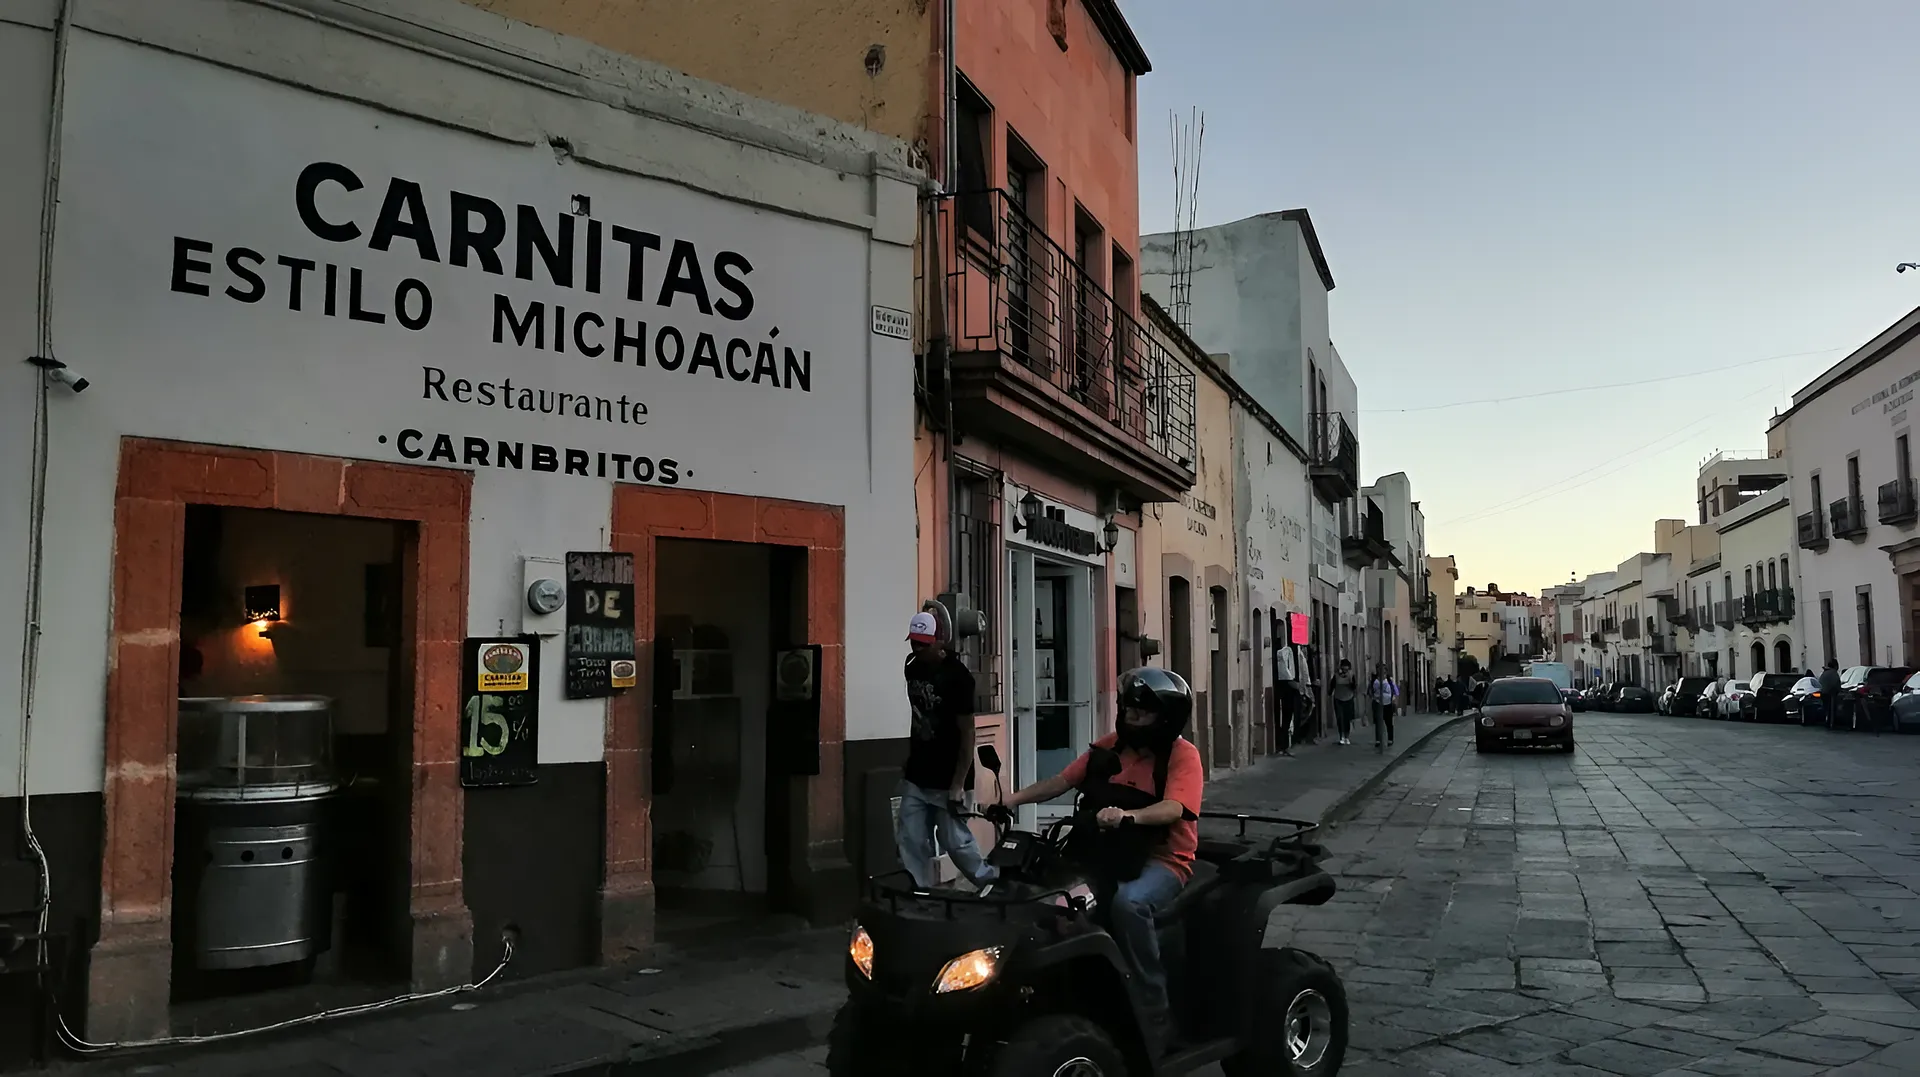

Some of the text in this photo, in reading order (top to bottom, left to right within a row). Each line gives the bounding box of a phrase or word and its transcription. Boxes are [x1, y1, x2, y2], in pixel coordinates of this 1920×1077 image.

[296, 161, 755, 322] CARNITAS
[170, 236, 812, 392] ESTILO MICHOACÁN
[422, 366, 649, 426] Restaurante
[584, 589, 622, 619] DE
[463, 694, 509, 757] 15
